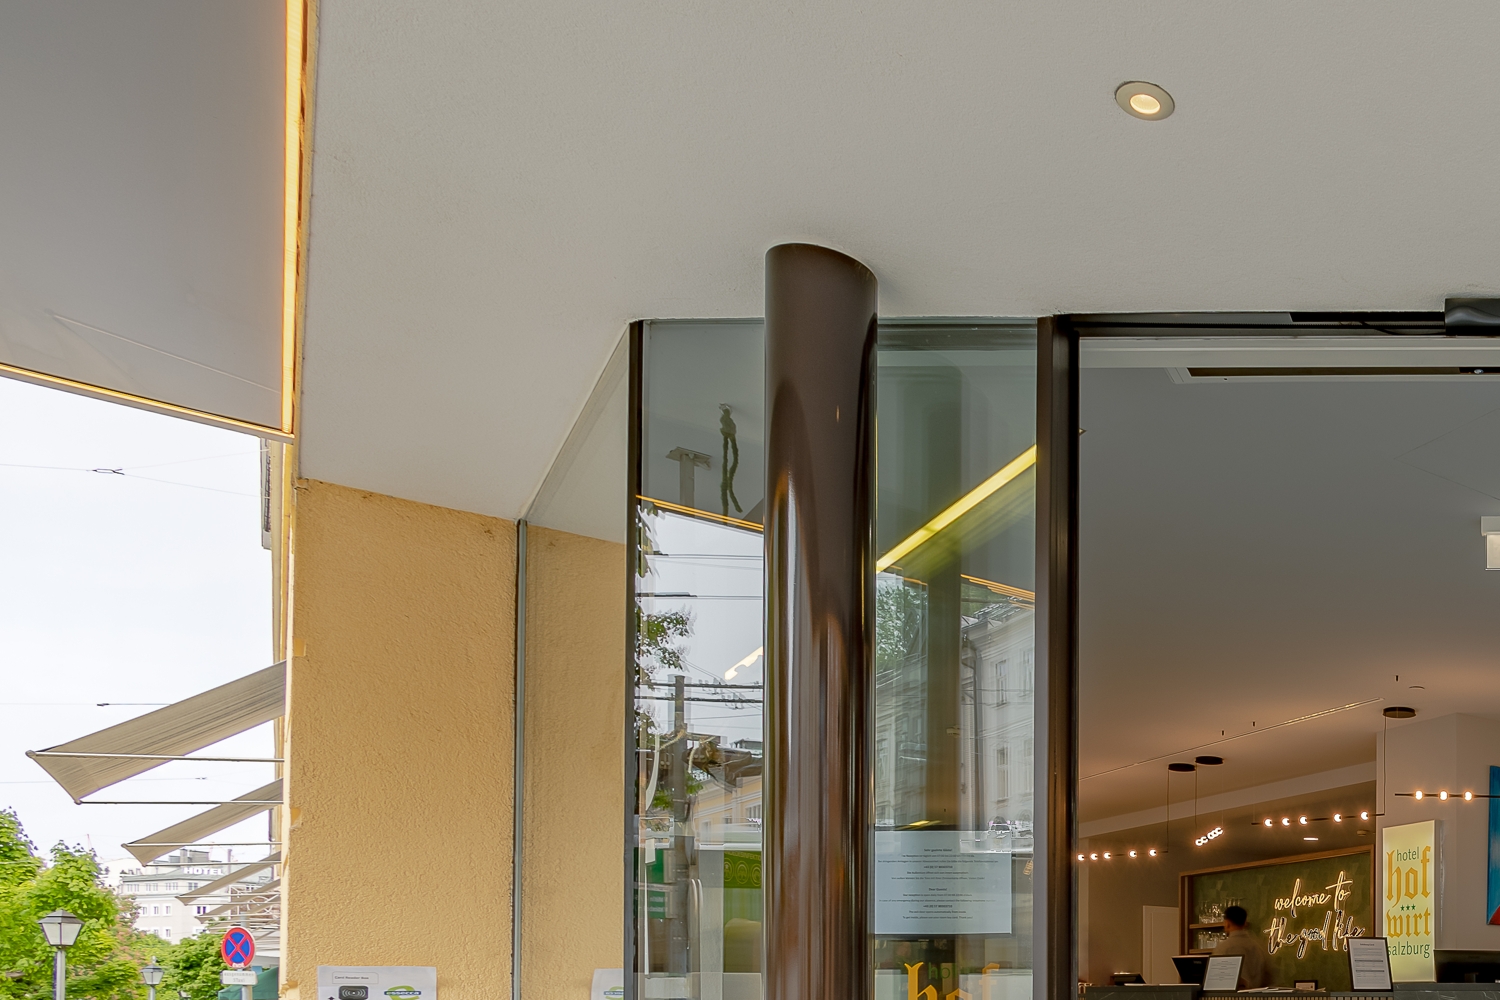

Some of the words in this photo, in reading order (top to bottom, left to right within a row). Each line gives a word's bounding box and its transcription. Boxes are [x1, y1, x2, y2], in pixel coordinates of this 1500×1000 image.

[1397, 846, 1420, 861] hotel
[183, 867, 223, 875] HOTEL
[1386, 845, 1431, 908] hof
[1275, 878, 1331, 918] welcome
[1325, 870, 1353, 912] to
[1263, 917, 1298, 955] the
[1297, 910, 1332, 959] good
[1332, 909, 1365, 951] life
[1386, 907, 1431, 938] wirt
[1387, 940, 1431, 958] salzburg
